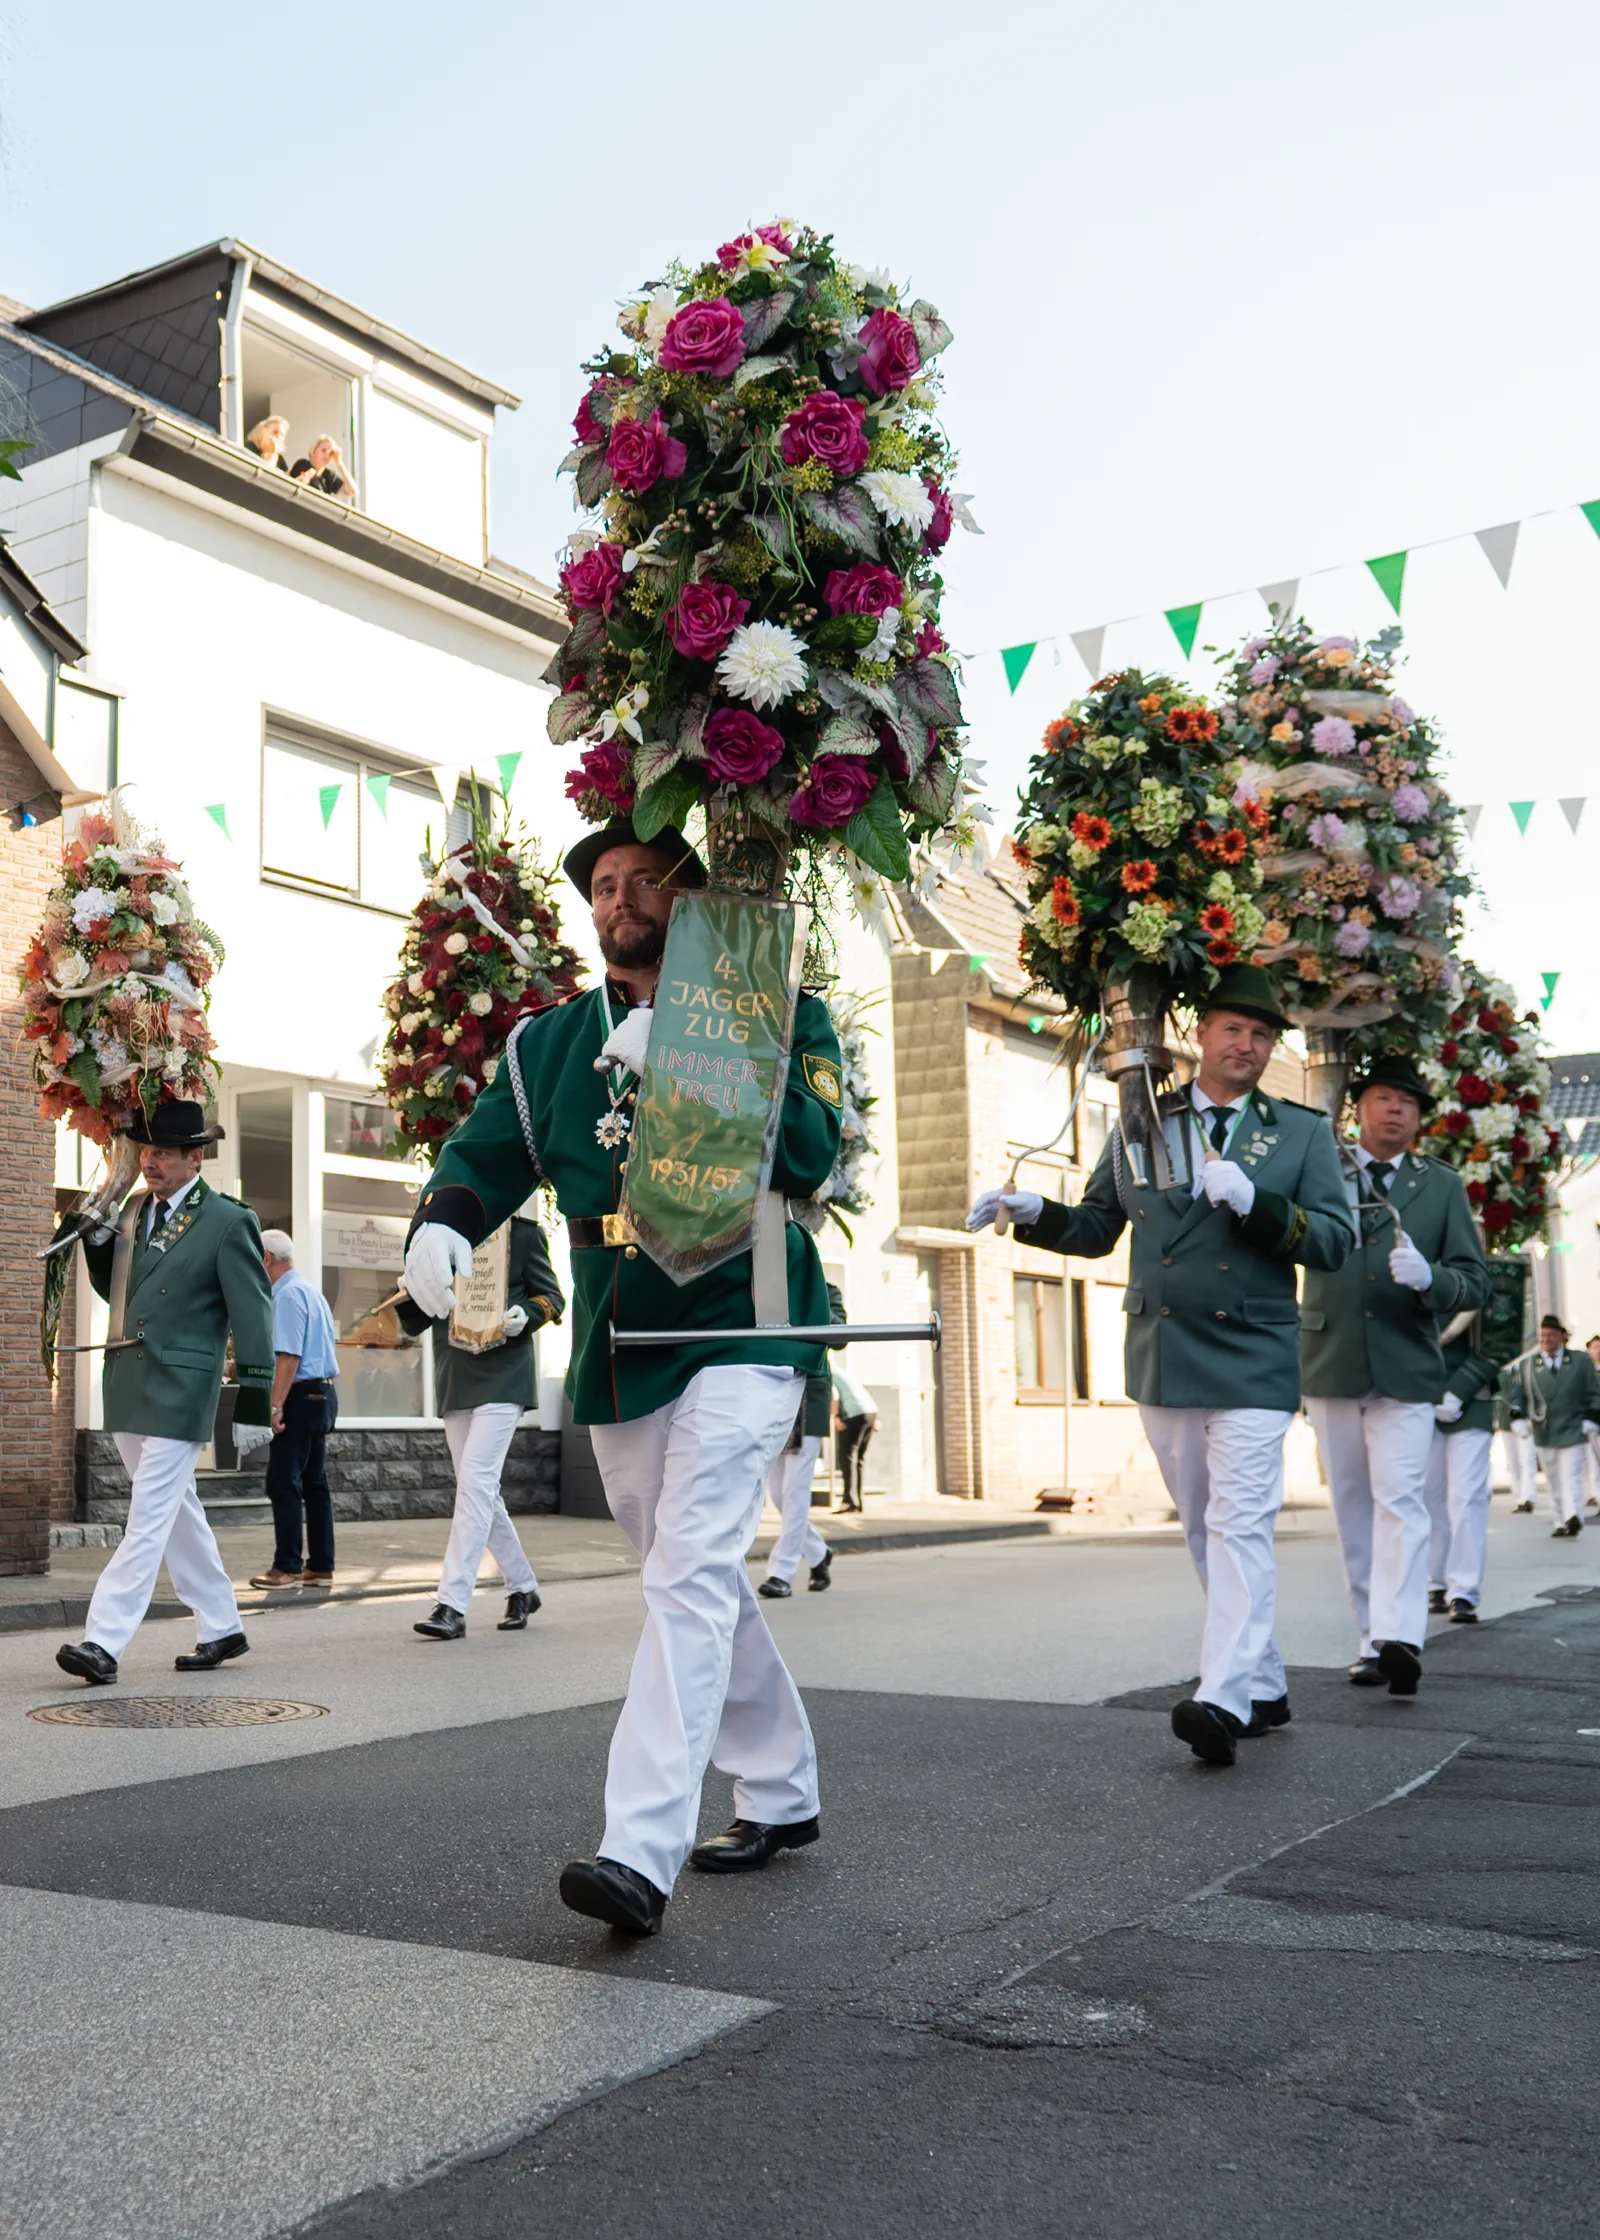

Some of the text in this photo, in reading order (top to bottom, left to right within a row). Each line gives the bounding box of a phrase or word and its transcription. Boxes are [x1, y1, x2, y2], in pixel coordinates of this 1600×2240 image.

[713, 952, 739, 982] 4.
[684, 1012, 749, 1044] ZUG
[657, 1045, 764, 1085] IMMER-
[671, 1076, 741, 1111] TREU
[648, 1158, 742, 1195] 1931/57
[464, 1280, 496, 1291] Hubert
[470, 1290, 488, 1301] und
